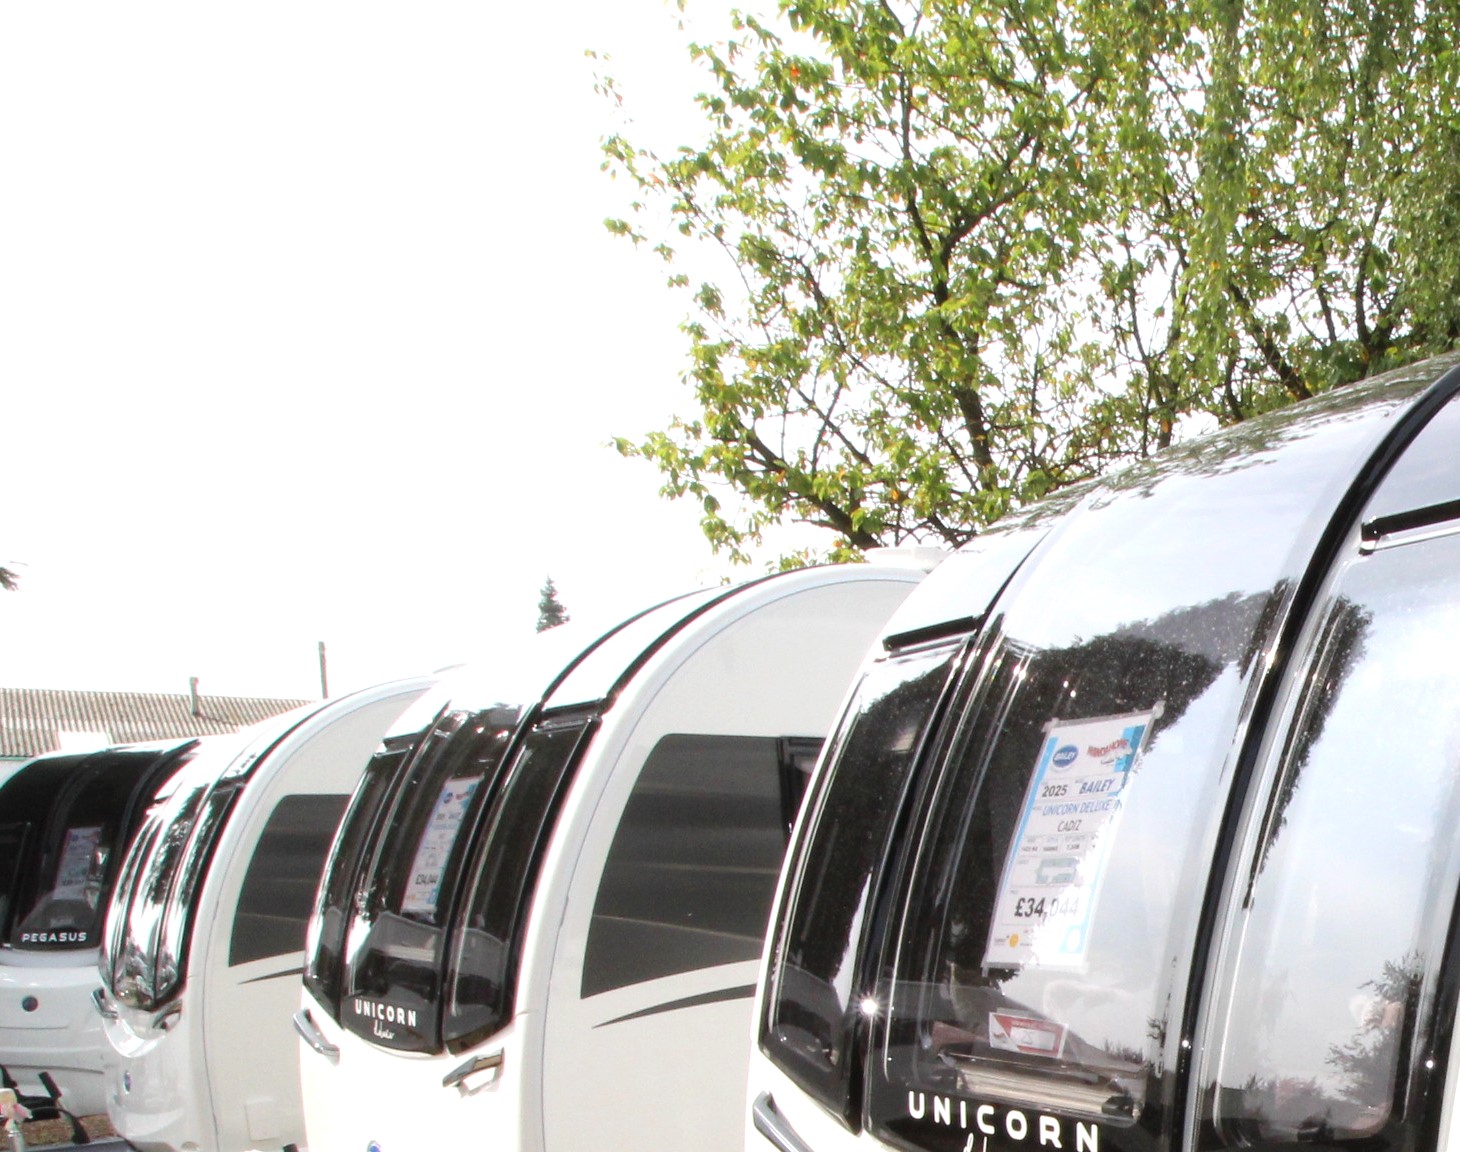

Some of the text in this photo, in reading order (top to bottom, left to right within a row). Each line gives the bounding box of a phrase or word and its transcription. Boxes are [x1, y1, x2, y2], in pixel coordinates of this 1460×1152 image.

[1042, 785, 1068, 798] 2025
[1080, 778, 1116, 794] BAILEY
[1042, 799, 1112, 816] UNICORN DELUXE
[1057, 819, 1082, 832] CADIZ
[22, 931, 87, 942] PEGASUS
[355, 999, 416, 1027] UNICORN
